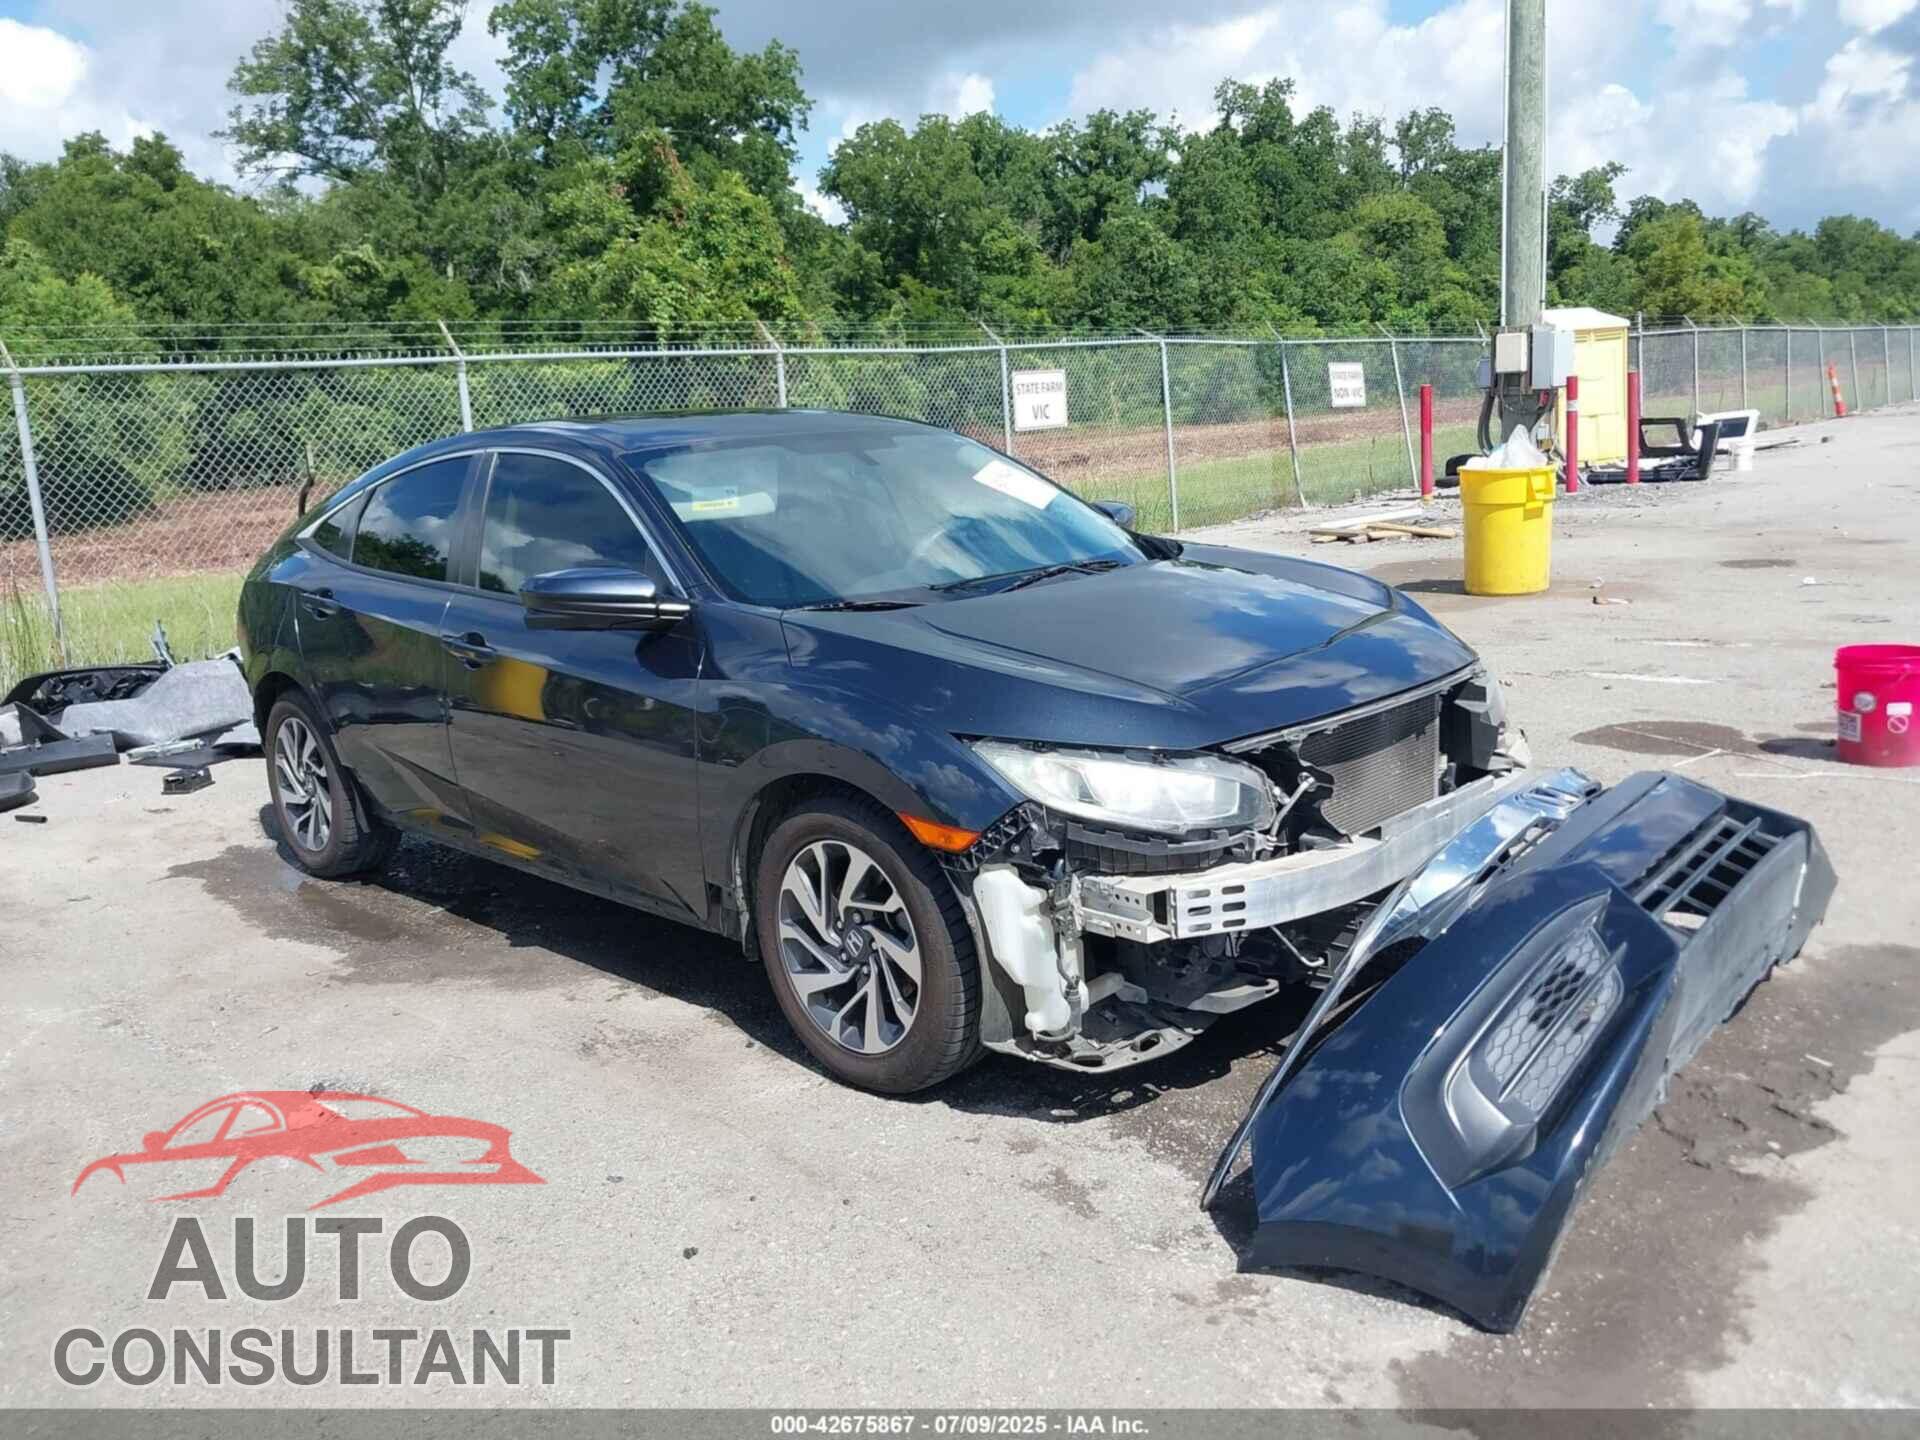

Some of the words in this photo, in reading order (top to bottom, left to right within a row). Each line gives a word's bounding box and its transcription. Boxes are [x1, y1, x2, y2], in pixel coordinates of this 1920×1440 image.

[1016, 382, 1040, 396] STATE
[1041, 381, 1063, 393] FARM
[1031, 403, 1050, 420] VIC
